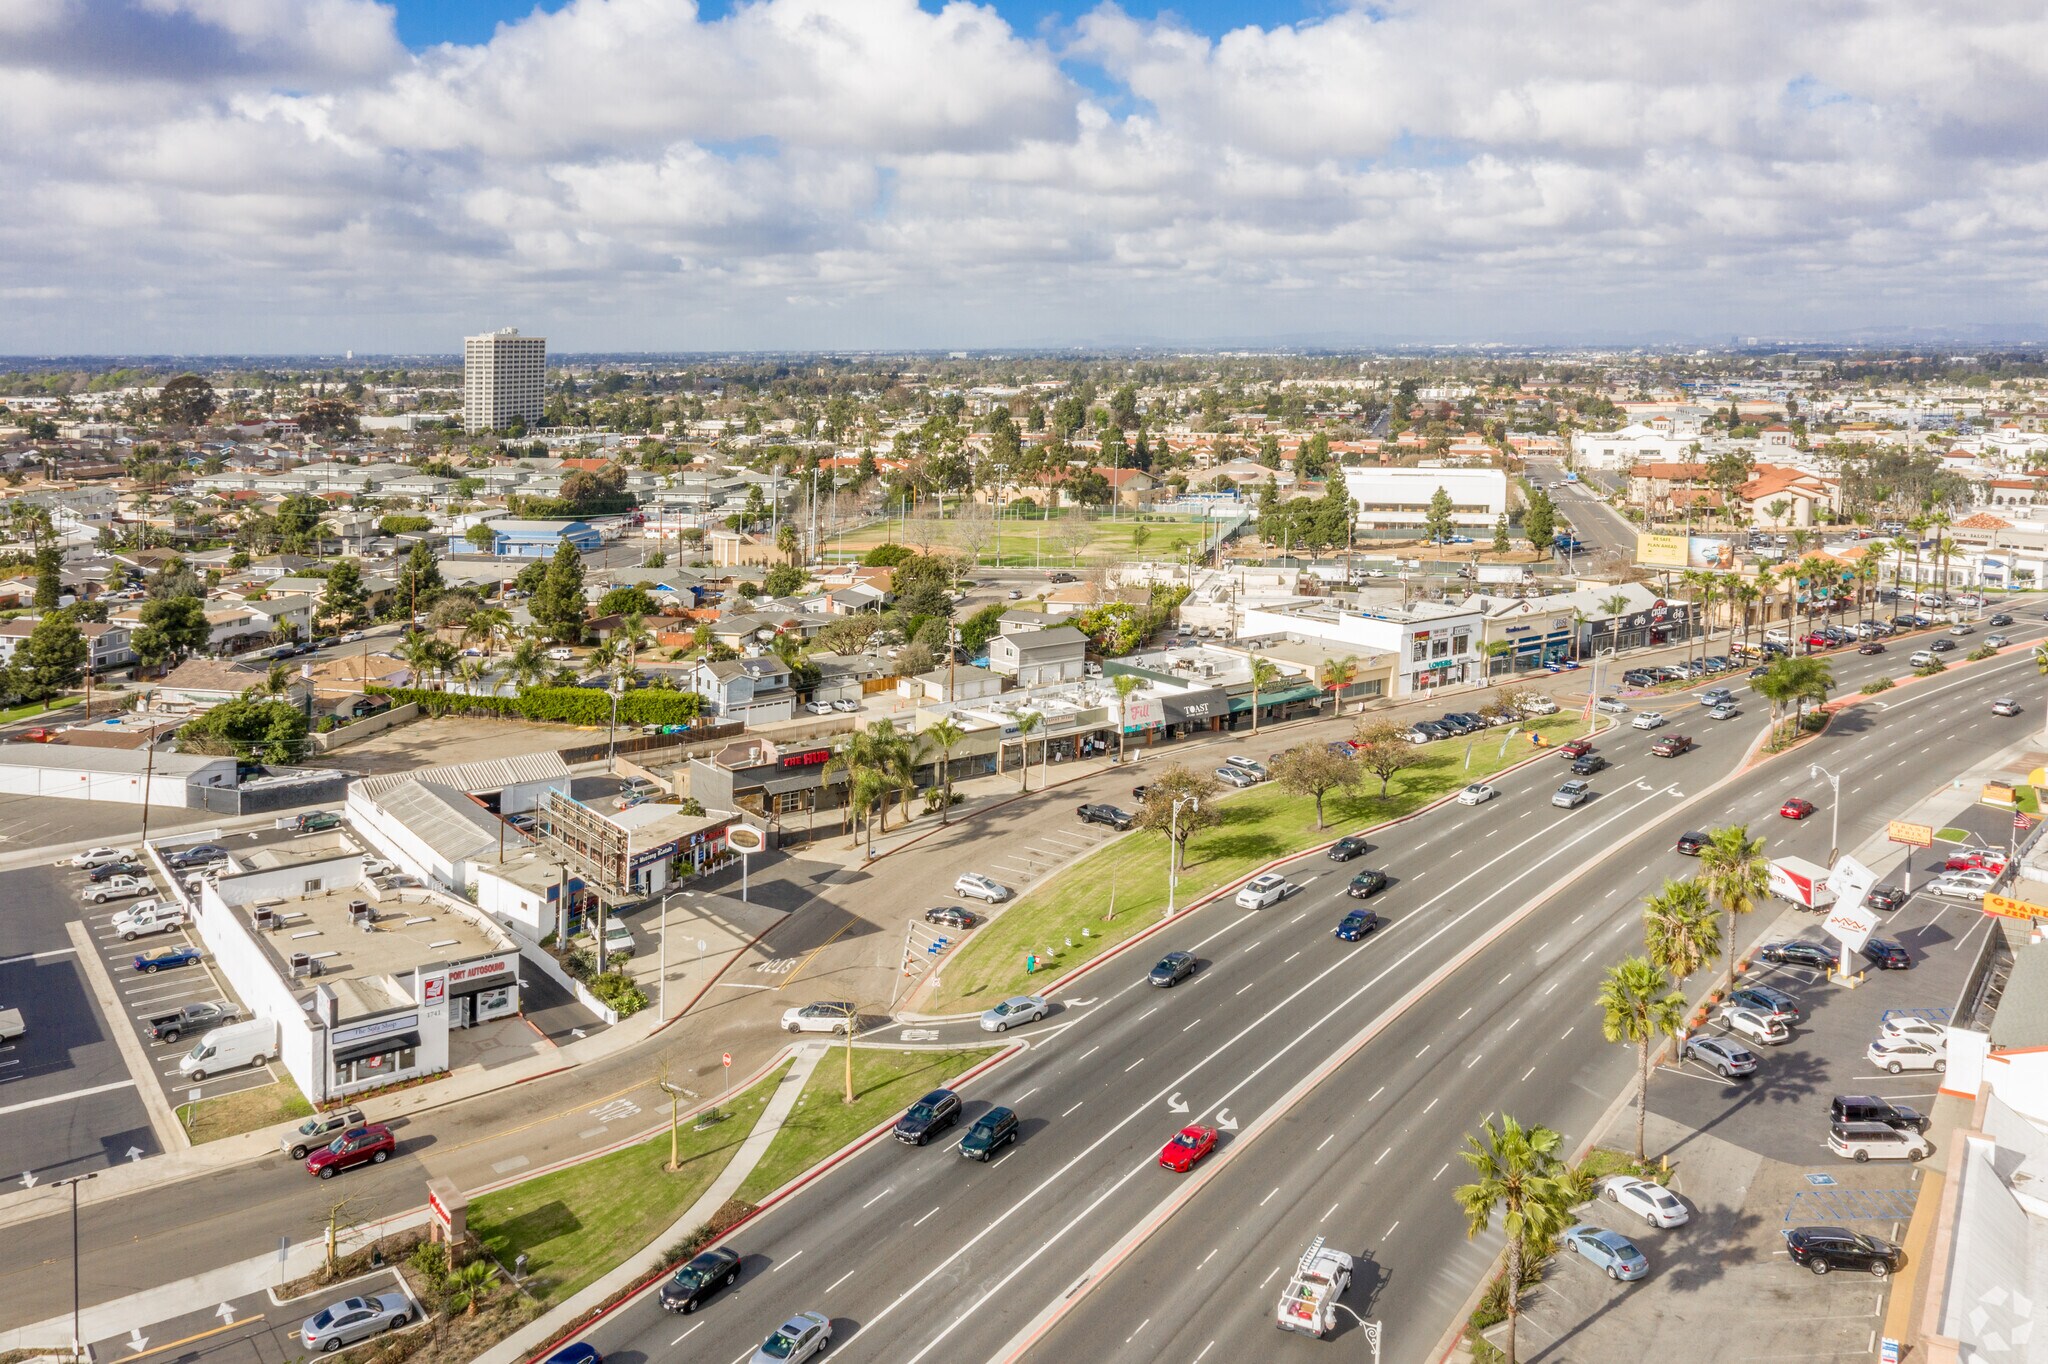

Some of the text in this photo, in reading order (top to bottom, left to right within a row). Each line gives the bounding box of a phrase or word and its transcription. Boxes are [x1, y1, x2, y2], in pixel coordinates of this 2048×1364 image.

[1428, 659, 1453, 669] LOVERS
[1130, 704, 1150, 720] Fill
[1184, 703, 1209, 714] TOAST
[784, 751, 829, 767] THE HUB
[1891, 822, 1930, 833] GRAND
[1897, 829, 1922, 838] PRIX
[468, 961, 505, 977] AUTOSOUND
[427, 1010, 441, 1018] 1741
[355, 1027, 367, 1035] The
[589, 1099, 641, 1123] STOP
